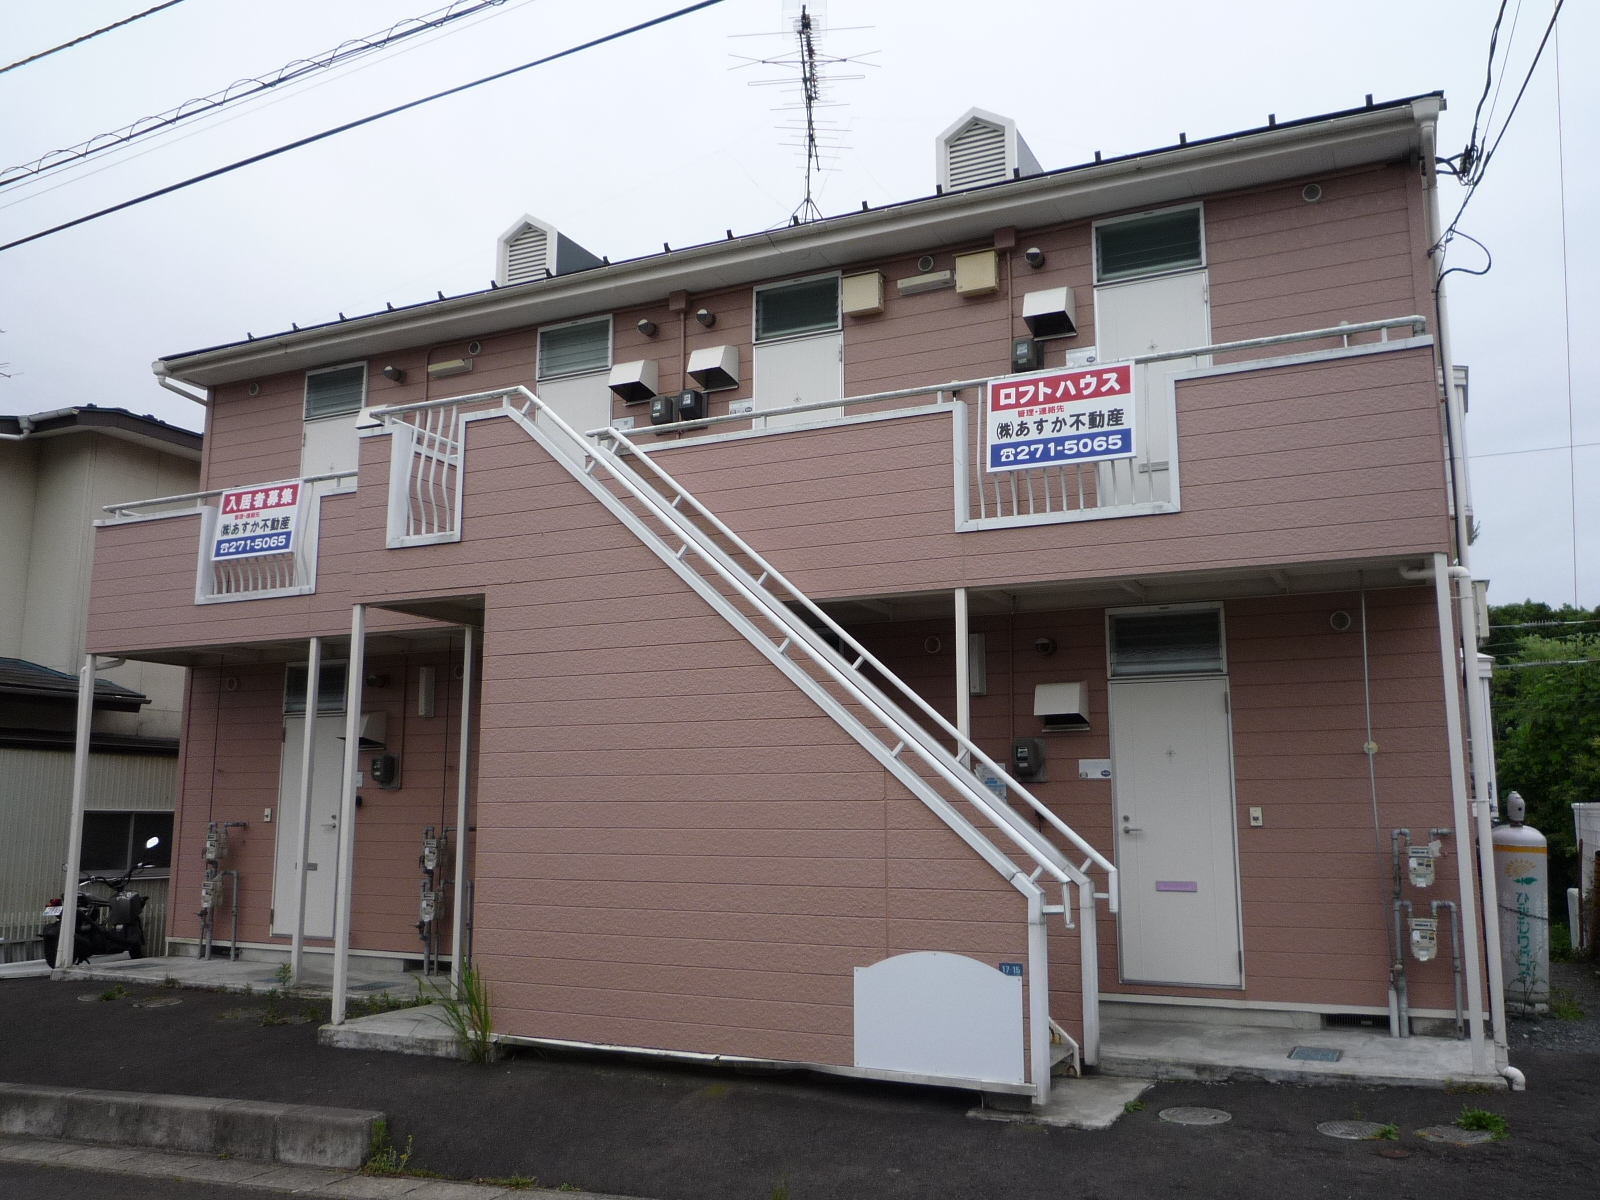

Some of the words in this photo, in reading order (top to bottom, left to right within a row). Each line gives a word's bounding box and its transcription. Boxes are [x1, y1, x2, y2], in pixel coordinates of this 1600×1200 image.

[1000, 372, 1120, 405] ロフトハウス
[1016, 434, 1122, 460] 271-5065
[226, 488, 293, 511] 入居者募集
[228, 536, 286, 552] 271-5065
